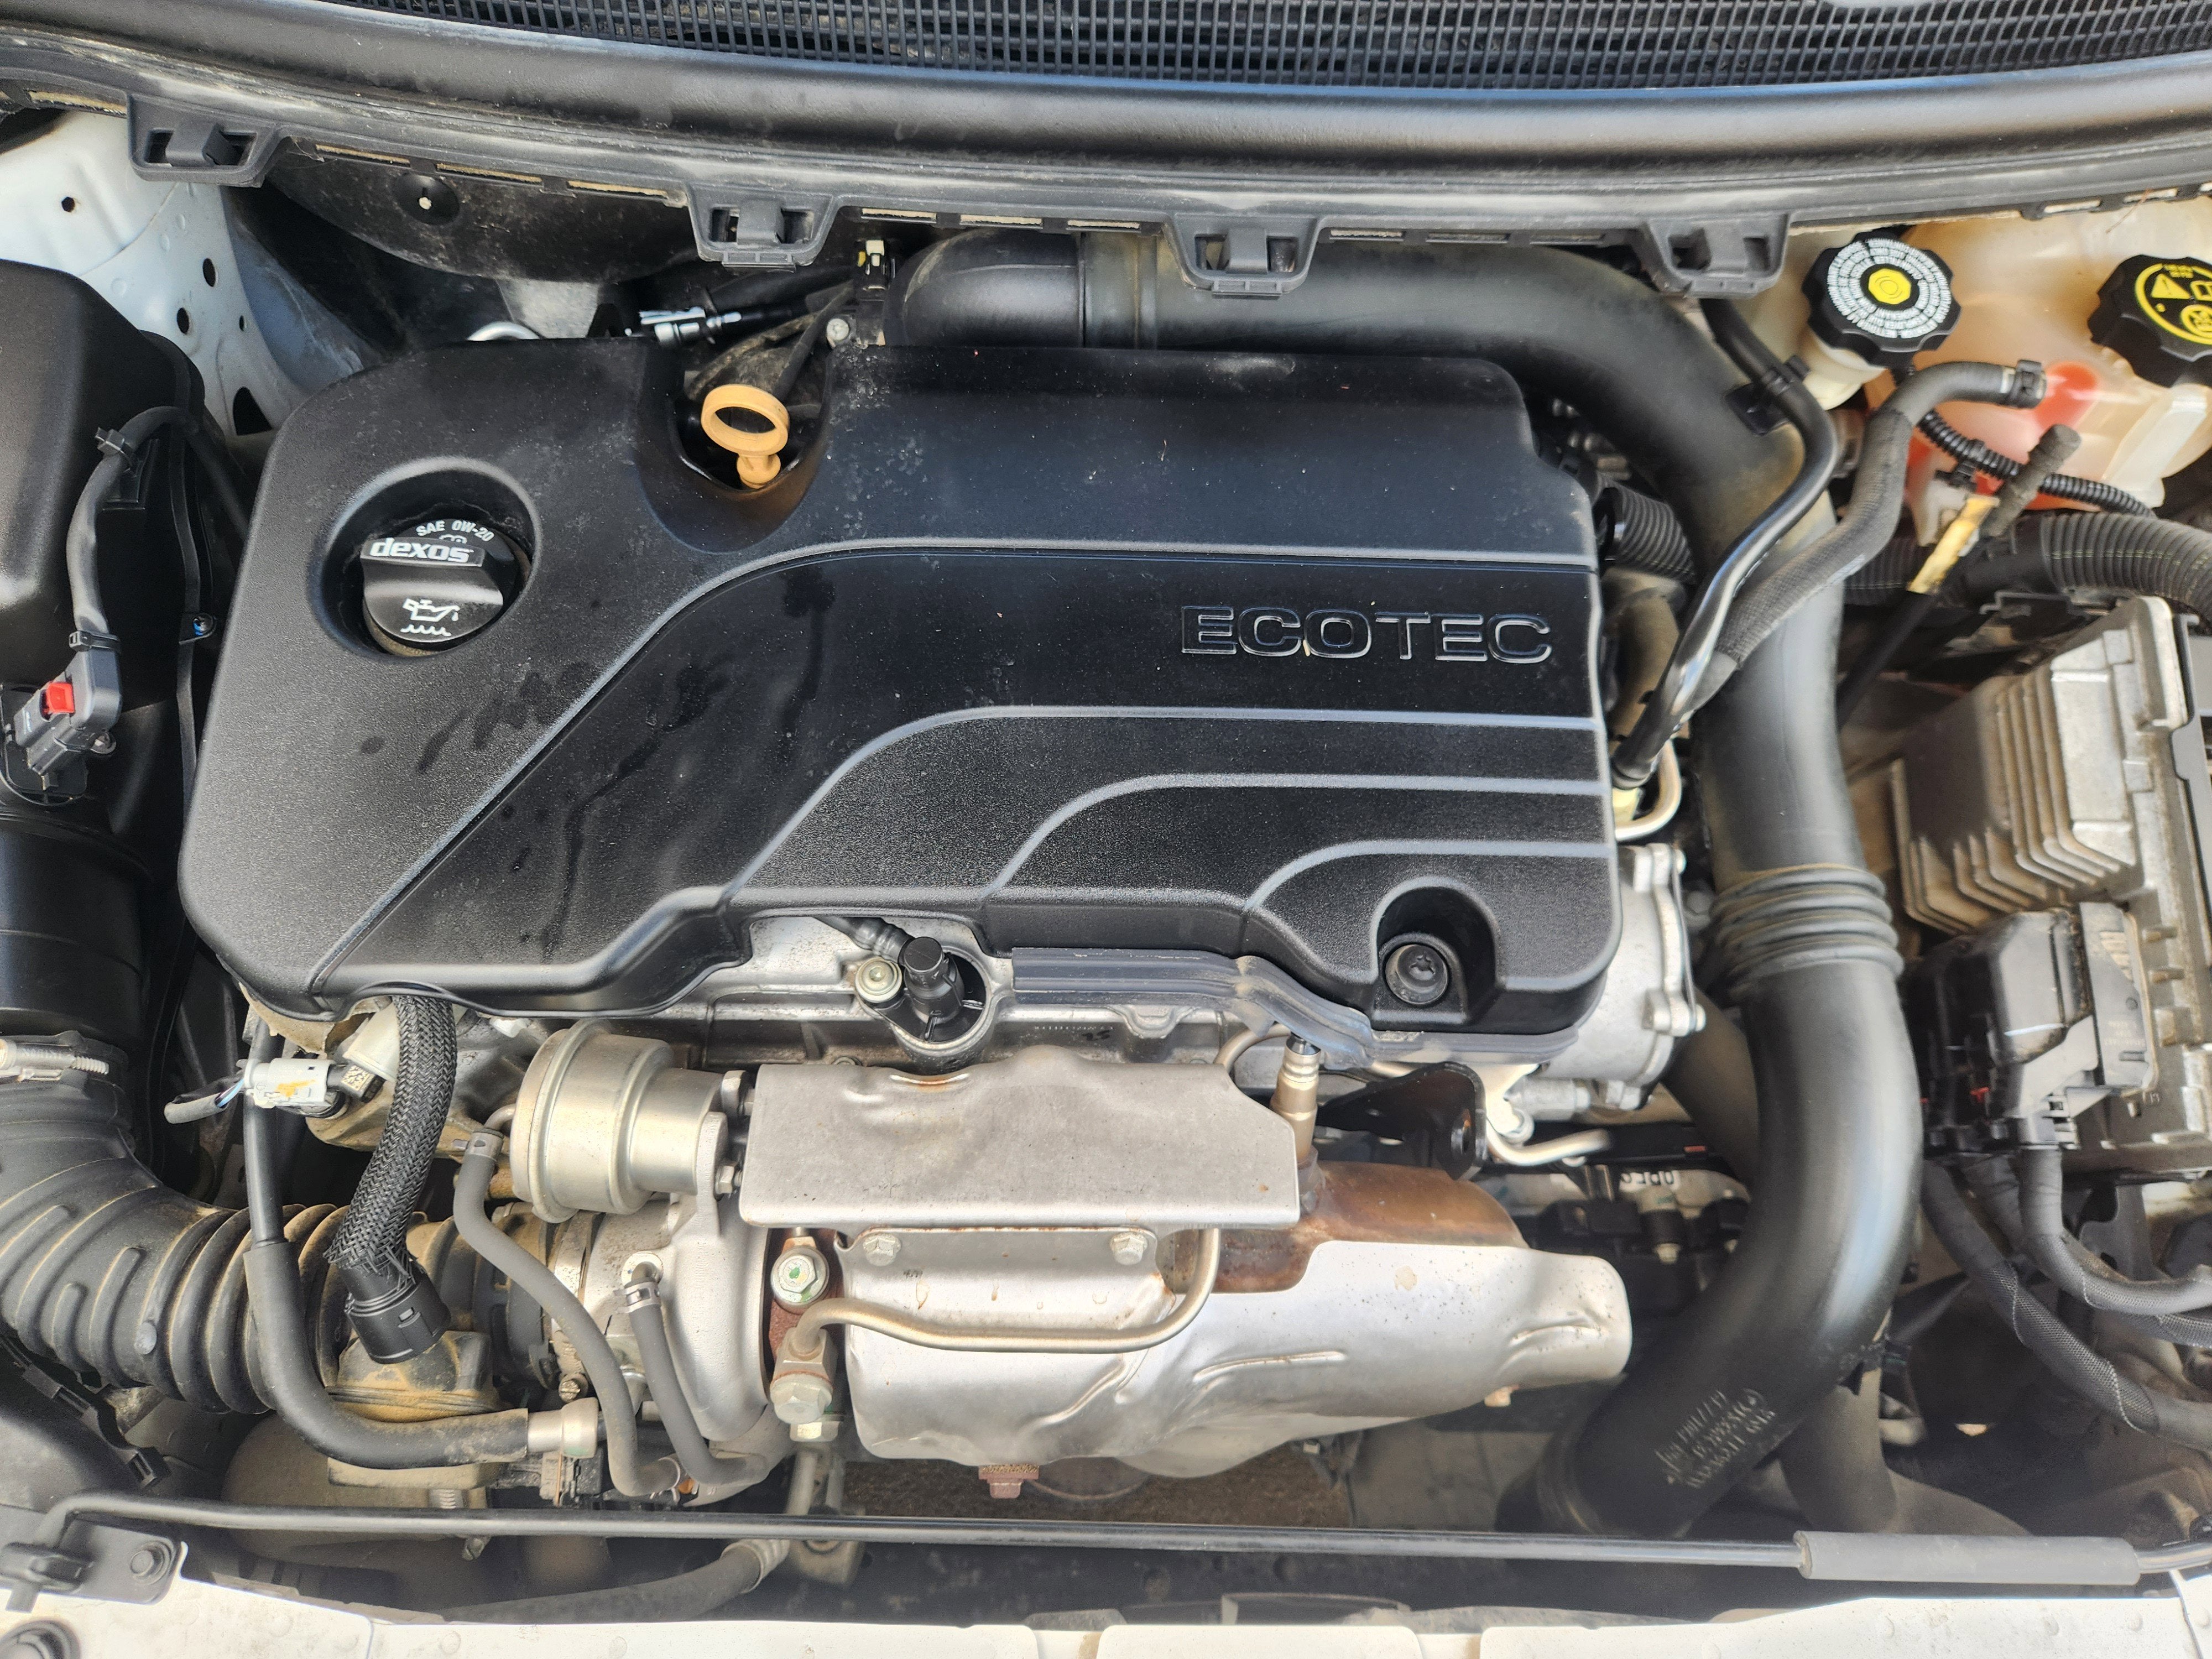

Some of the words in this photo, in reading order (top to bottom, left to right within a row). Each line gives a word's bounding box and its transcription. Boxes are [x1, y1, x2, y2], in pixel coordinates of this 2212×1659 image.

[416, 520, 445, 536] SAE
[451, 520, 495, 541] 0W-20
[369, 537, 471, 564] dexos
[1181, 606, 1553, 664] ECOTEC
